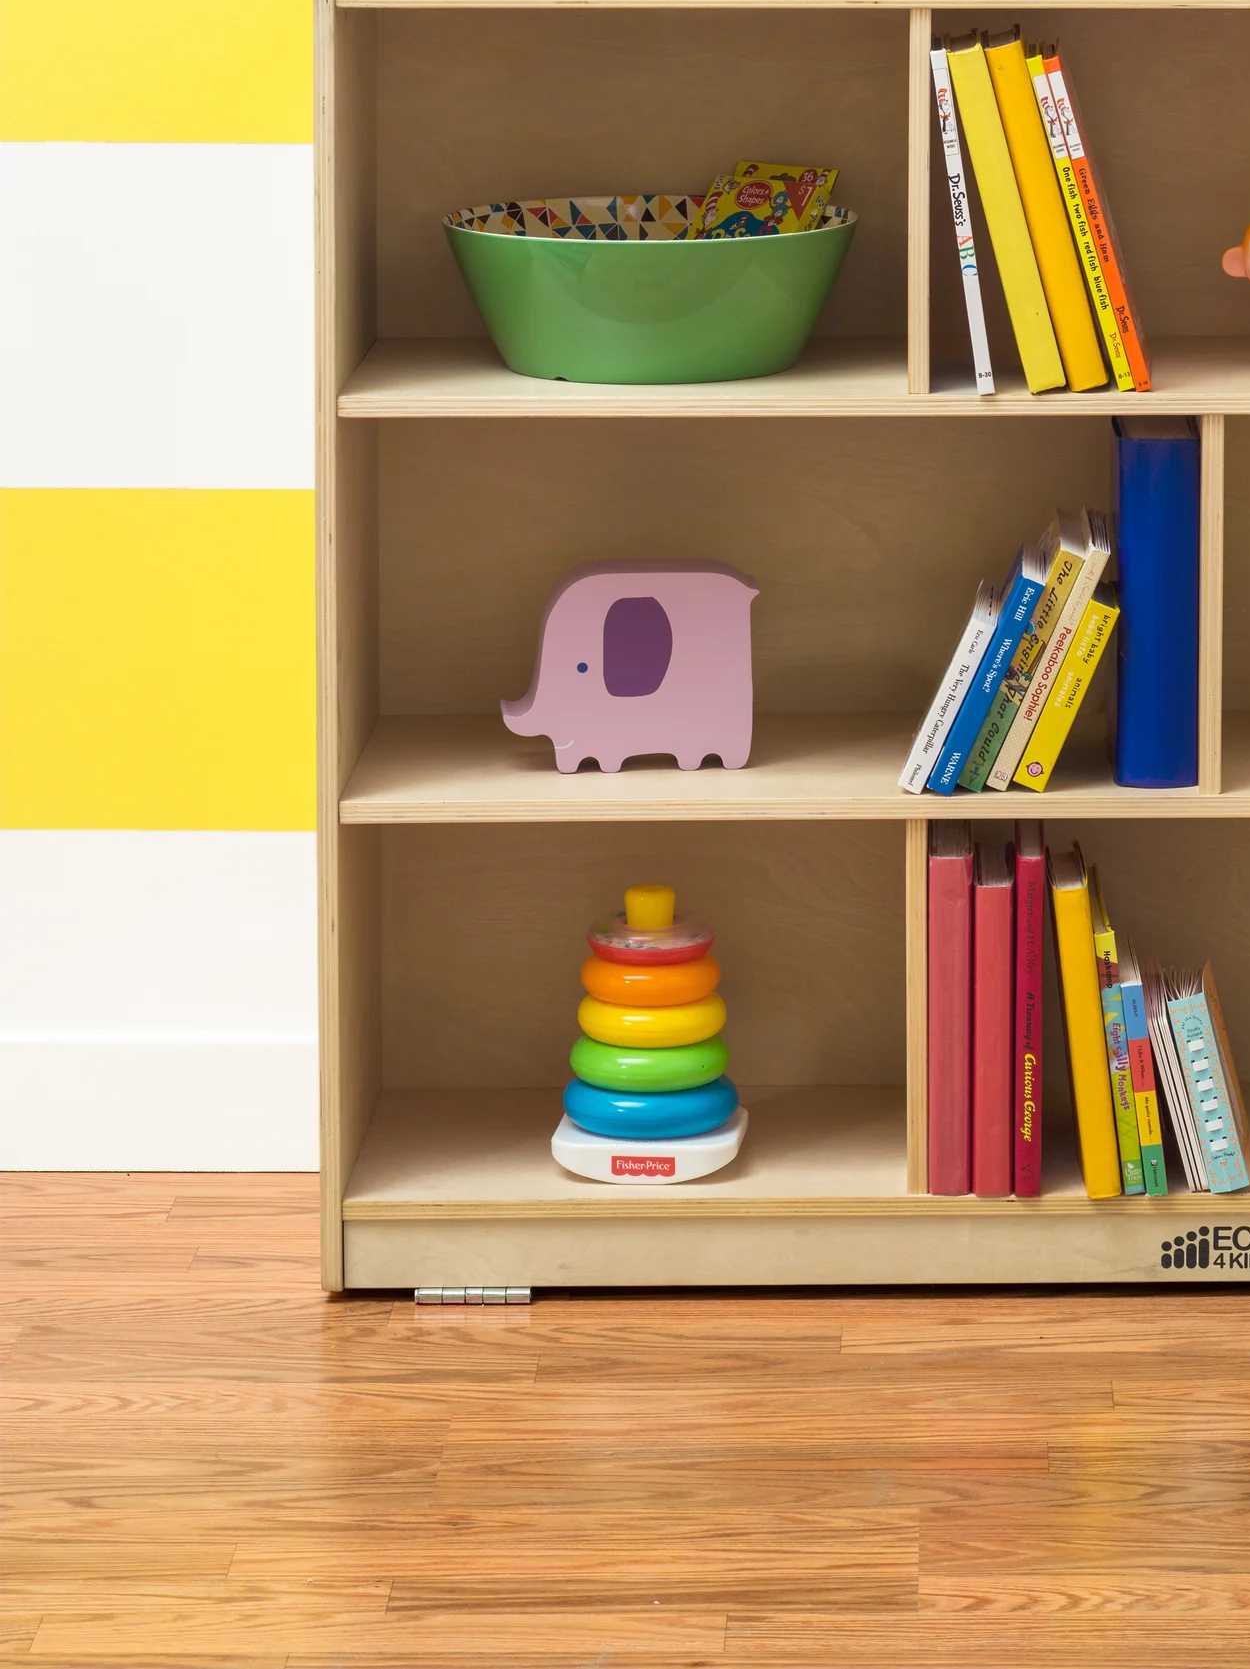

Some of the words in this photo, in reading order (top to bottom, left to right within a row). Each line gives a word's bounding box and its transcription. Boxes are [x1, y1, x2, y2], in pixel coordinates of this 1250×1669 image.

[801, 171, 814, 182] 36
[949, 173, 960, 191] Dr.
[952, 191, 966, 227] Seuss's
[1079, 168, 1091, 194] Green
[1087, 198, 1099, 220] Eggs
[1094, 223, 1105, 240] and
[1100, 243, 1109, 263] Ham
[1062, 166, 1071, 182] One
[1067, 183, 1078, 199] fish
[1073, 203, 1082, 219] two
[1078, 220, 1087, 237] fish
[1083, 241, 1093, 254] red
[1088, 255, 1098, 272] fish
[1093, 276, 1103, 293] blue
[1099, 294, 1109, 311] fish
[1056, 560, 1073, 585] The
[1024, 586, 1035, 605] Eric
[1037, 587, 1058, 629] Little
[1014, 605, 1027, 621] Hill
[1096, 614, 1111, 643] bright
[992, 638, 1012, 669] Where's
[1014, 633, 1040, 682] Engine
[1042, 626, 1073, 681] Peekaboo
[1076, 636, 1091, 657] listo
[1083, 643, 1099, 664] baby
[958, 664, 970, 677] The
[982, 669, 998, 693] Spot?
[949, 679, 963, 693] Very
[1054, 671, 1074, 707] animales
[1065, 677, 1082, 709] animals
[938, 694, 956, 719] Hungry
[1023, 682, 1048, 722] Sophie!
[923, 719, 944, 754] Caterpillar
[978, 722, 1000, 762] Could
[940, 752, 961, 785] WARNE
[1104, 950, 1113, 989] Haskamp
[1026, 992, 1035, 1001] A
[1023, 1002, 1035, 1040] Treasury
[1109, 1022, 1122, 1045] Eight
[1023, 1041, 1034, 1050] of
[1112, 1045, 1129, 1072] Silly
[1024, 1053, 1036, 1099] Curious
[1117, 1074, 1130, 1111] Monkeys
[1020, 1100, 1036, 1142] George
[616, 1159, 671, 1171] Fisher-Price
[1213, 1252, 1226, 1269] 4
